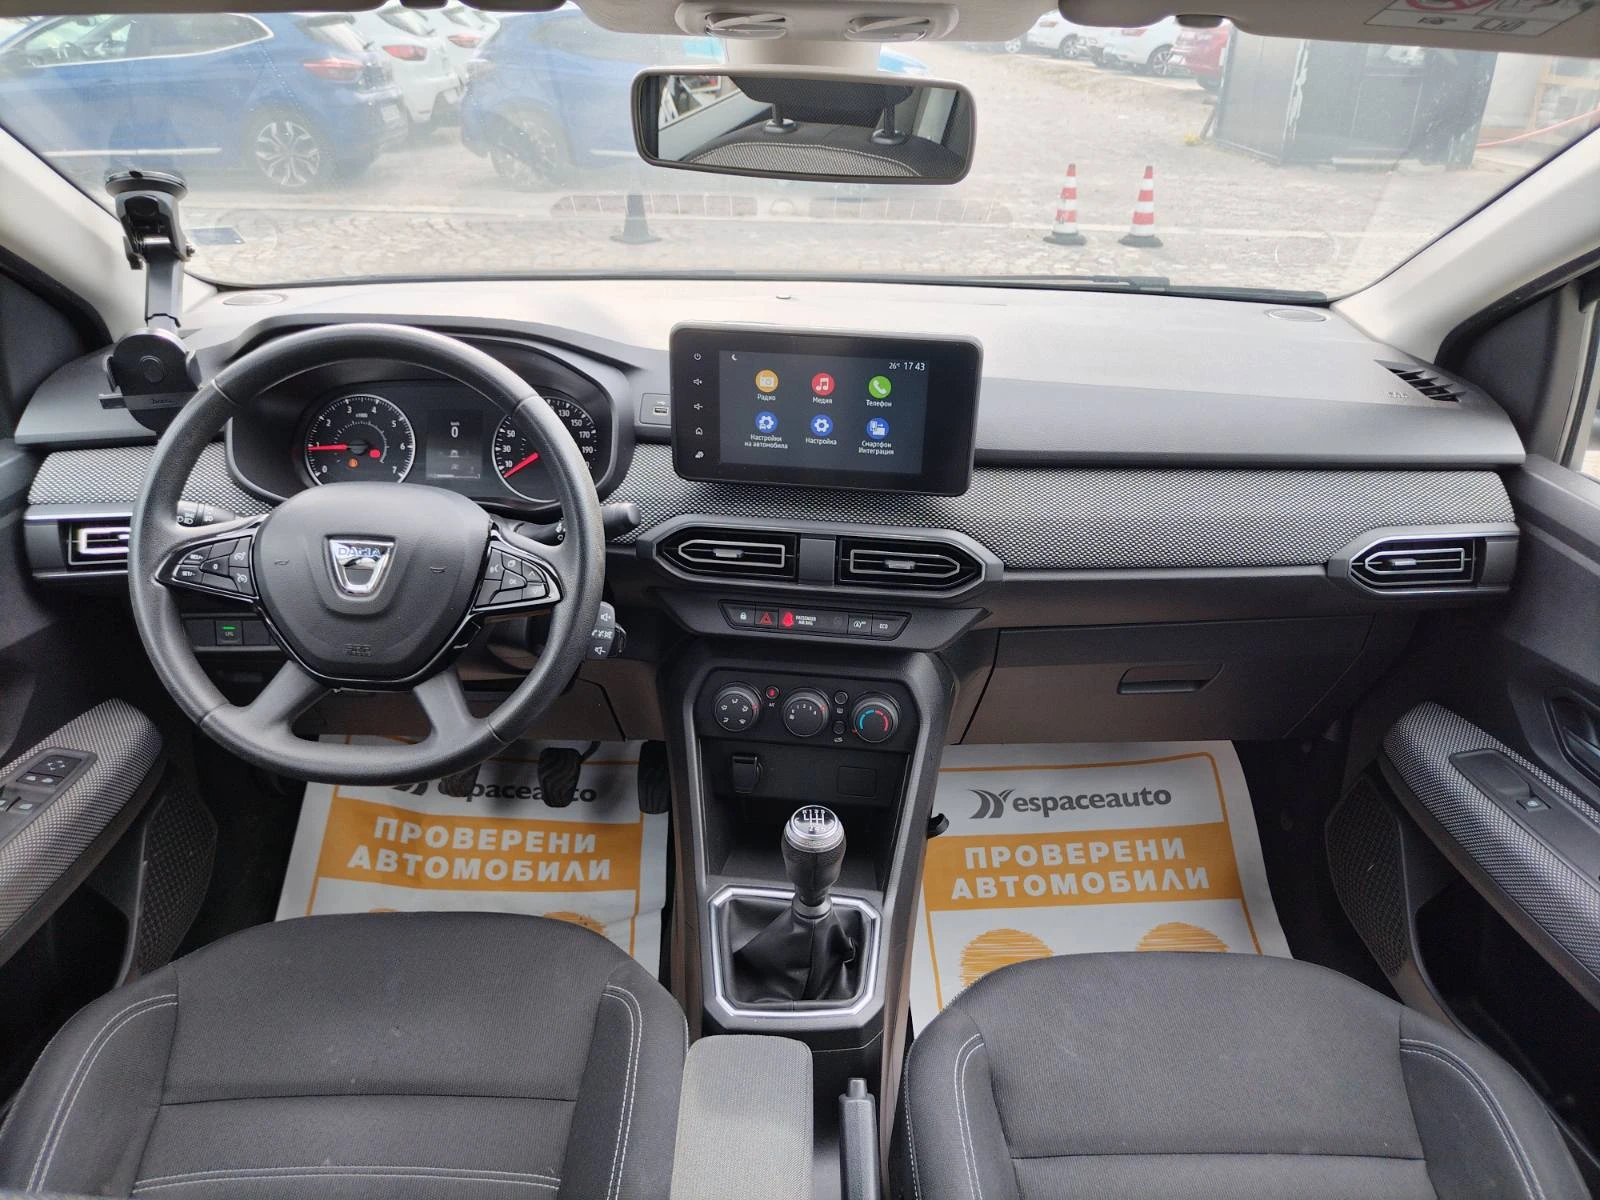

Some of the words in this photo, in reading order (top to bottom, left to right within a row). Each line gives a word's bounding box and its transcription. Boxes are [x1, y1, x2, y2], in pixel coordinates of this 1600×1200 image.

[812, 396, 833, 405] Медия
[866, 399, 893, 408] Телефон
[346, 405, 353, 414] 3
[371, 405, 377, 414] 4
[558, 409, 570, 417] 130
[325, 419, 332, 427] 2
[391, 420, 397, 428] 5
[571, 419, 583, 427] 150
[451, 426, 459, 438] 0
[506, 430, 516, 438] 50
[579, 431, 591, 439] 170
[399, 442, 406, 450] 6
[502, 445, 512, 453] 30
[861, 440, 892, 449] Смартфон
[581, 446, 594, 454] 190
[858, 447, 895, 455] Интеграция
[504, 460, 513, 468] 10
[338, 547, 381, 557] DACIA
[1012, 787, 1172, 818] espaceauto
[373, 816, 597, 854] ПРОВЕРЕНИ
[965, 837, 1186, 870] ПРОВЕРЕНИ
[347, 844, 611, 882] АВТОМОБИЛИ
[951, 866, 1210, 900] АВТОМОБИЛИ
